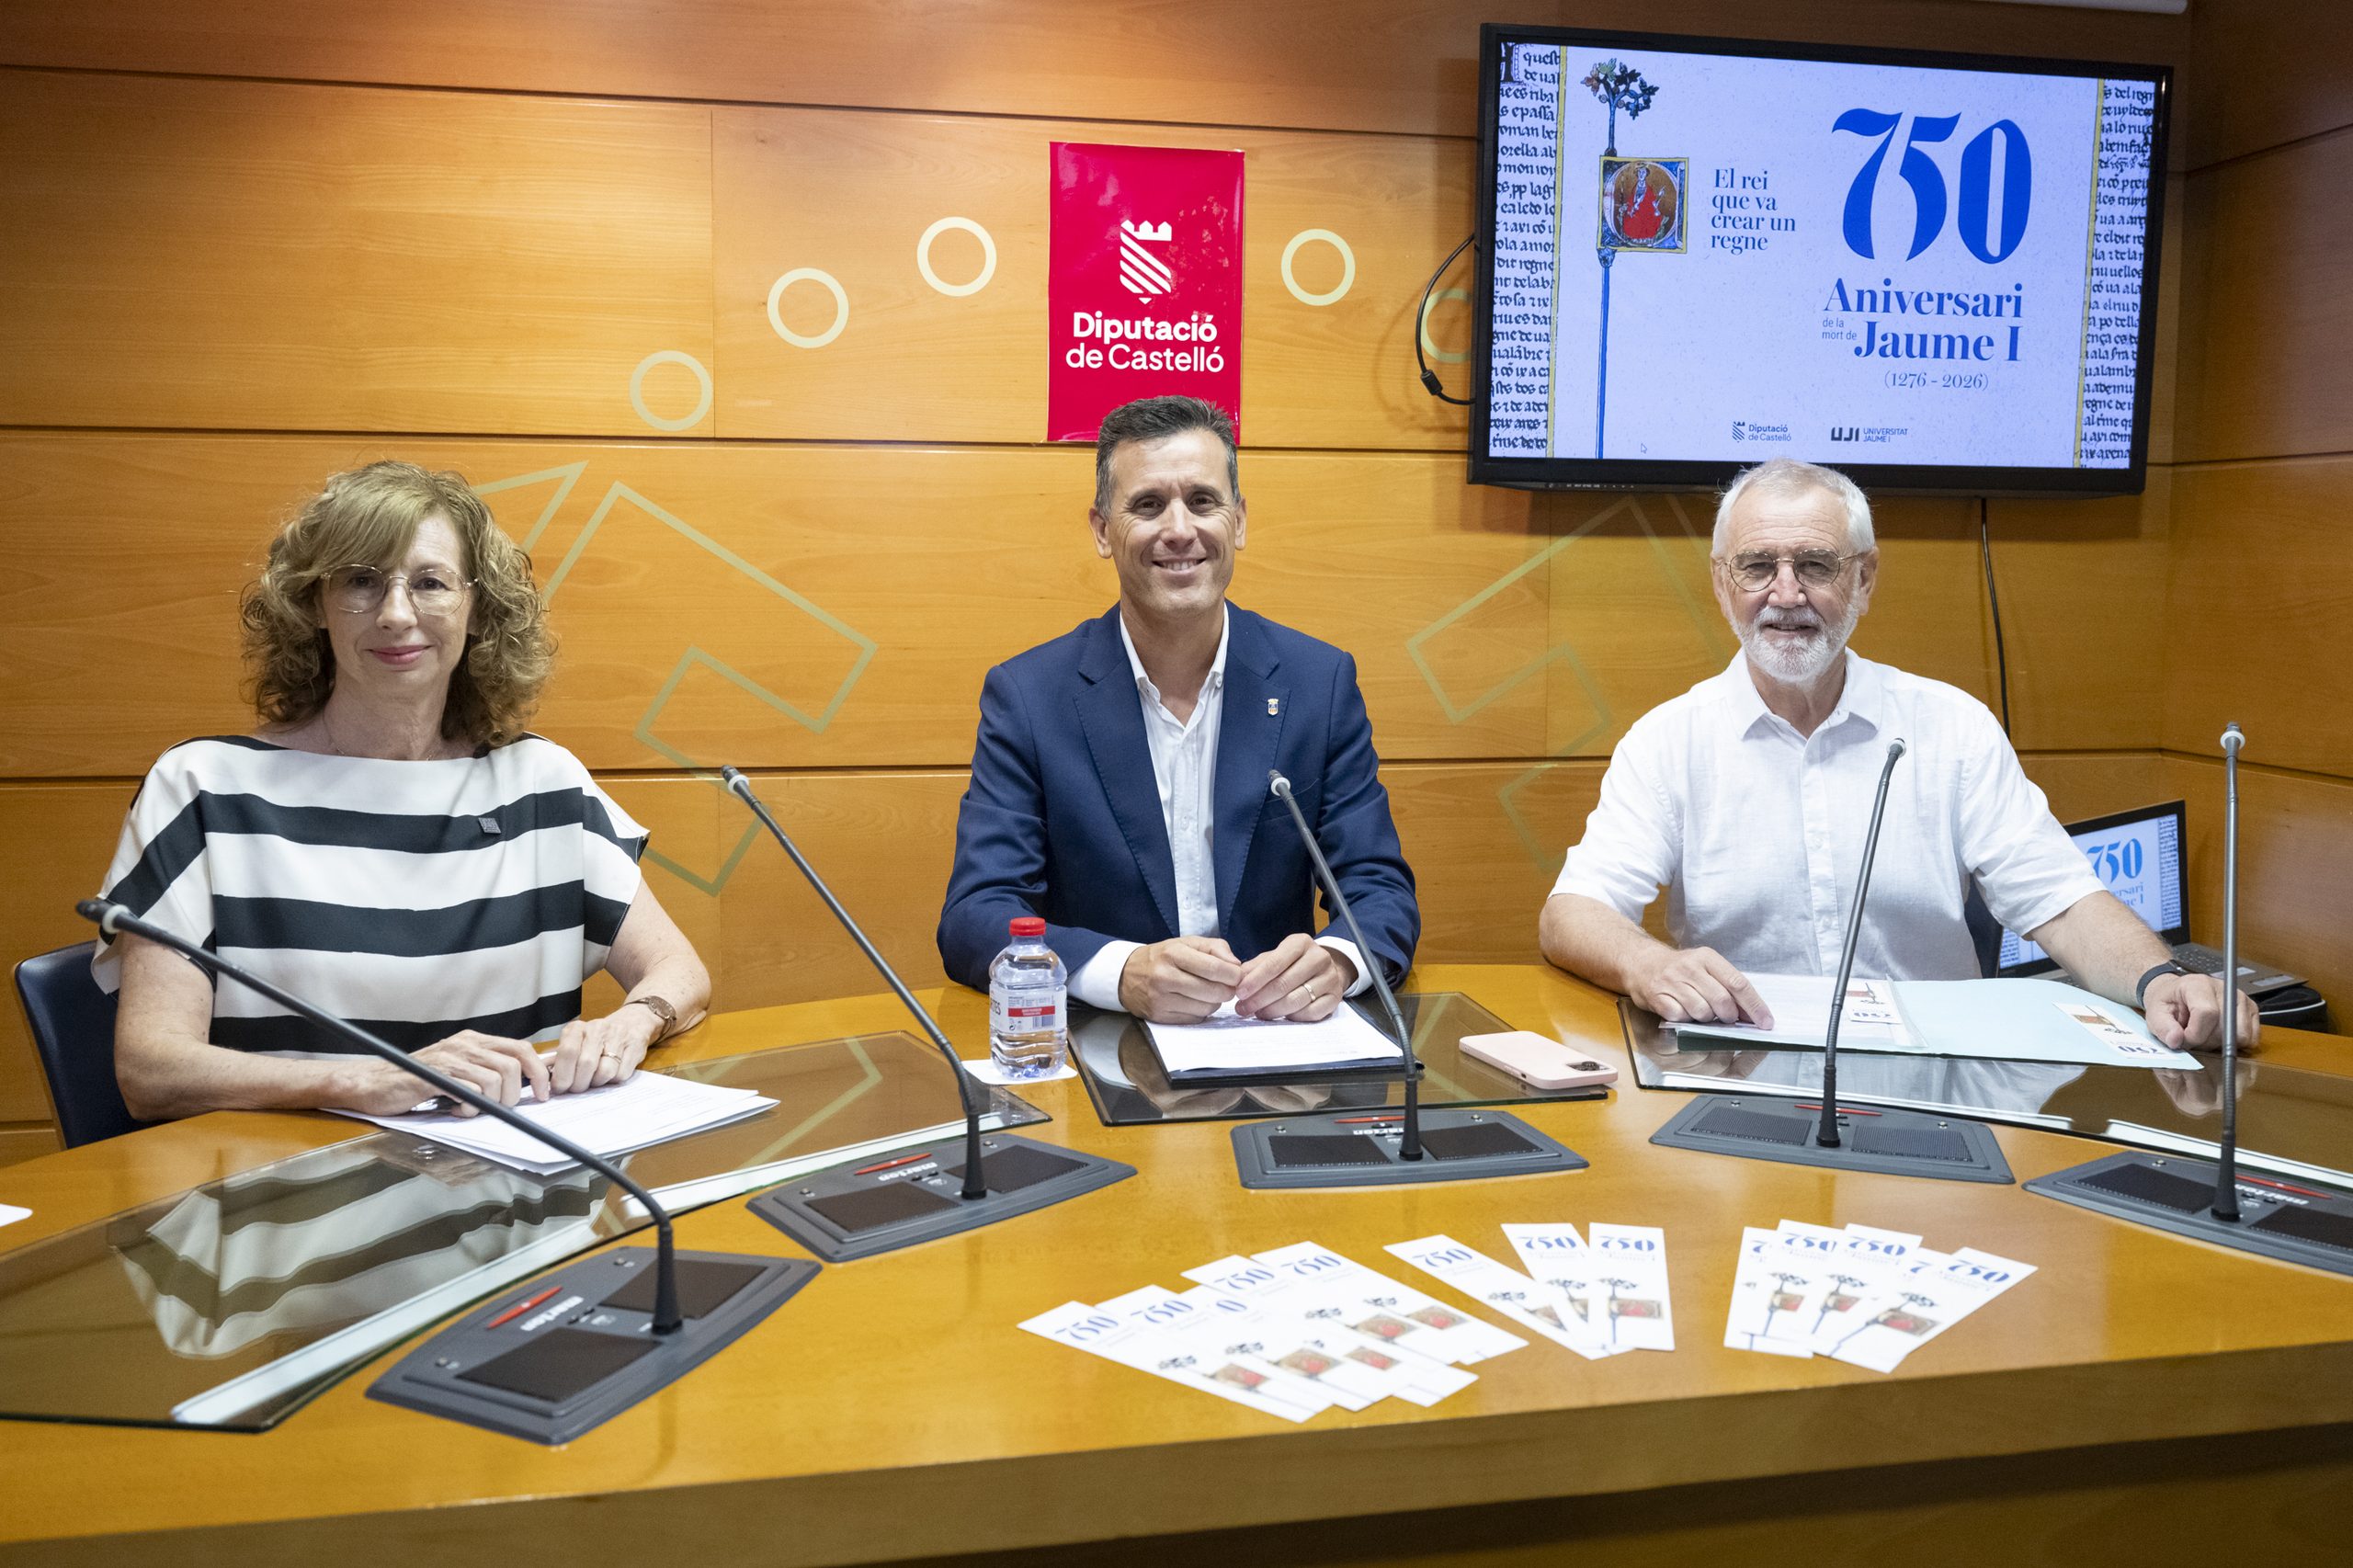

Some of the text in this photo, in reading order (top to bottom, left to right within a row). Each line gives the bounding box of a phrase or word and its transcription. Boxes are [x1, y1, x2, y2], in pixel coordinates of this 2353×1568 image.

[1714, 168, 1768, 190] El rei
[1832, 108, 2031, 264] 750
[1712, 195, 1778, 213] que va
[1711, 215, 1796, 232] crear un
[1711, 235, 1768, 256] regne
[1824, 278, 2022, 318] Aniversari
[1074, 311, 1217, 345] Diputació
[1823, 318, 1844, 327] de la
[1822, 331, 1857, 340] mort de
[1854, 321, 2023, 361] Jaume I
[1065, 343, 1224, 372] de Castelló
[1748, 424, 1789, 434] Diputació
[1759, 433, 1791, 442] Castelló
[1863, 427, 1908, 436] UNIVERSITAT
[2086, 838, 2143, 883] 750
[1518, 1236, 1576, 1250] 750
[1599, 1235, 1654, 1251] 750
[1848, 1235, 1906, 1256] 750
[1280, 1256, 1341, 1275] 750
[1412, 1248, 1472, 1267] 750
[1949, 1259, 2010, 1282] 750
[1055, 1315, 1119, 1341] 750
